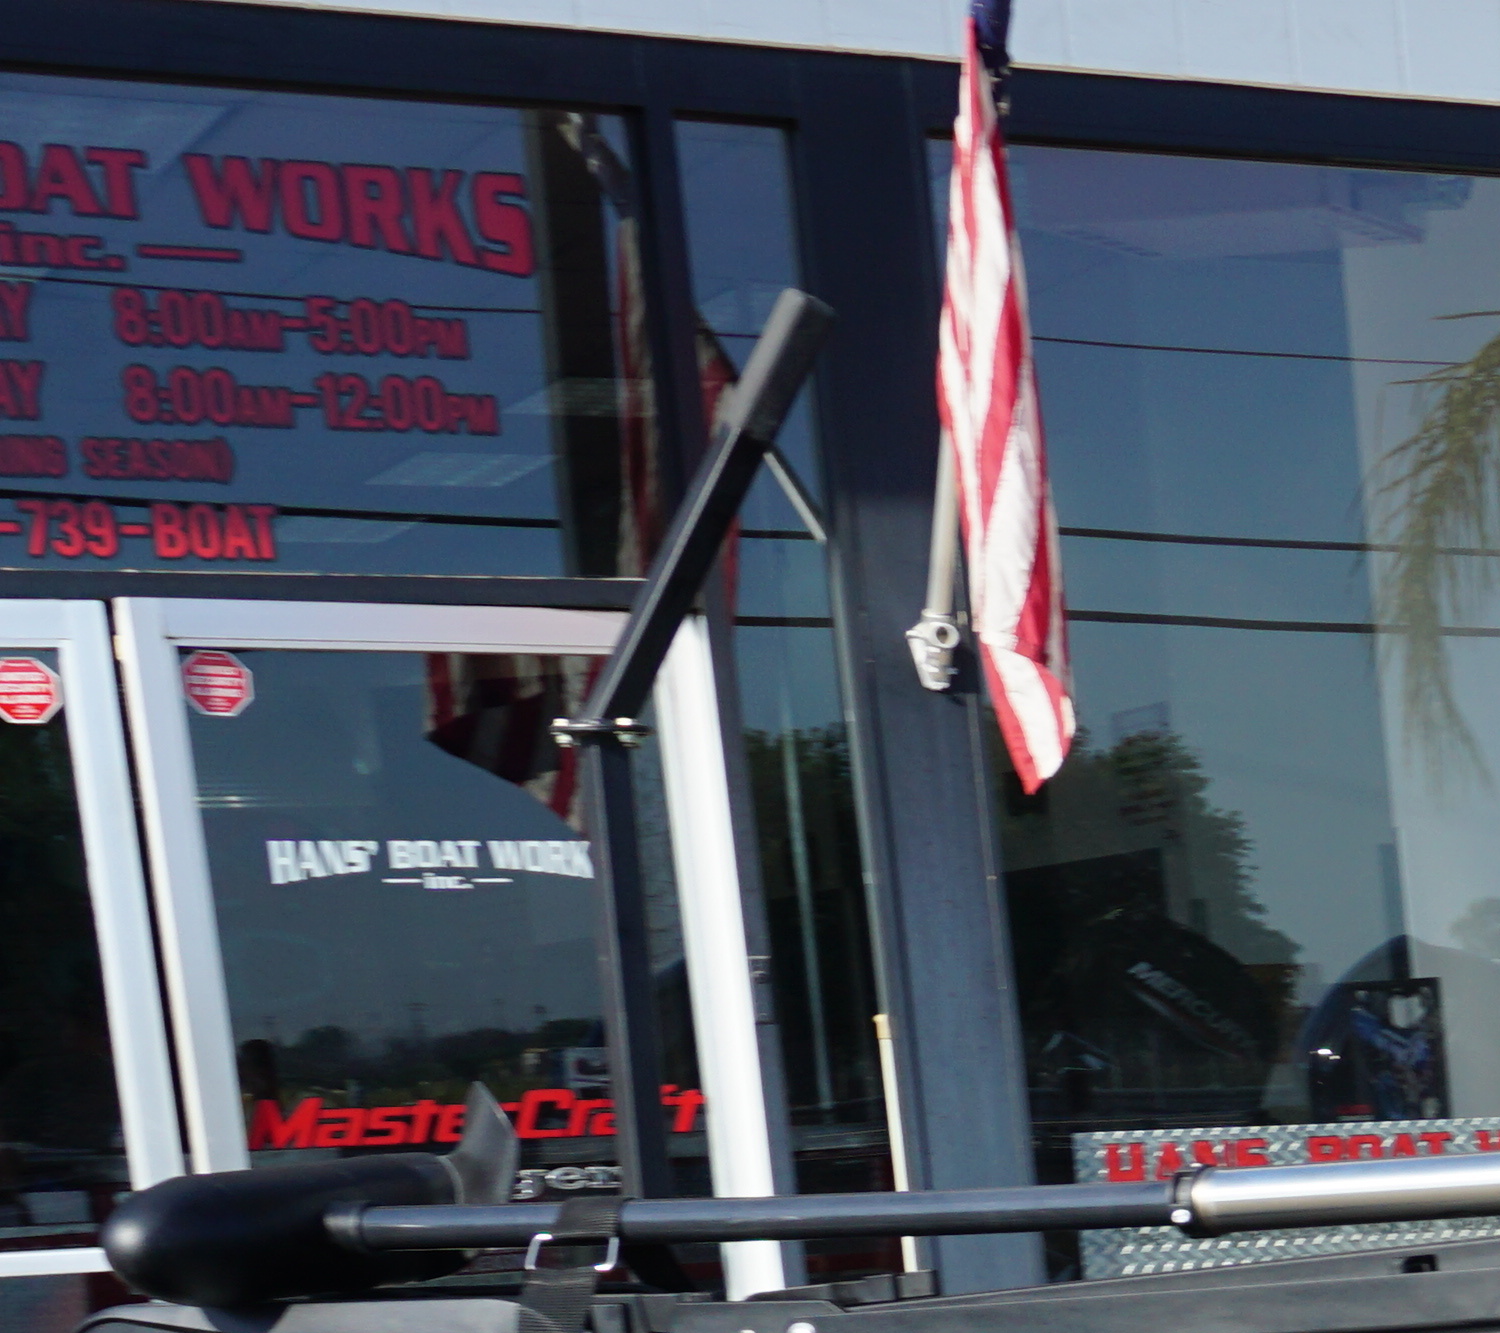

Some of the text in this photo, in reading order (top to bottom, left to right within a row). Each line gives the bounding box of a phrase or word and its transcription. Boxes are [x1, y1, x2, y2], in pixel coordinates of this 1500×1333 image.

[183, 153, 537, 278] WORKS
[265, 839, 379, 885] HANS'
[387, 839, 483, 869] BOAT
